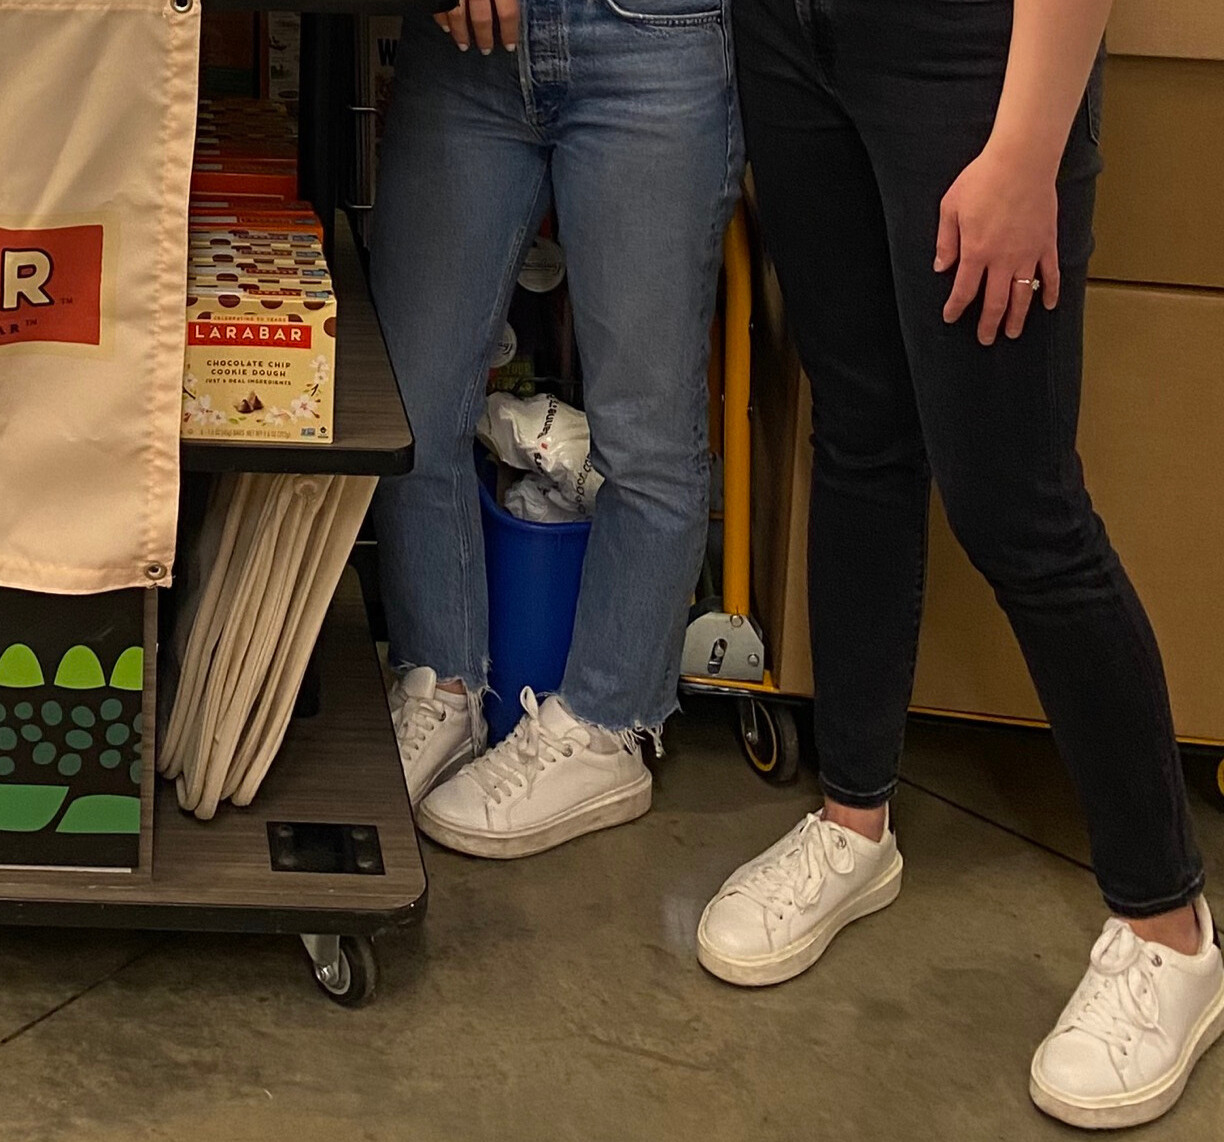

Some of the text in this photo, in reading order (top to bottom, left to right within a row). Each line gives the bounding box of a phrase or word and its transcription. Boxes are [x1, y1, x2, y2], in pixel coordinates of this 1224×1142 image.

[206, 360, 292, 369] CHOCOLATE CHIP
[210, 368, 286, 377] COOKIE DOUGH
